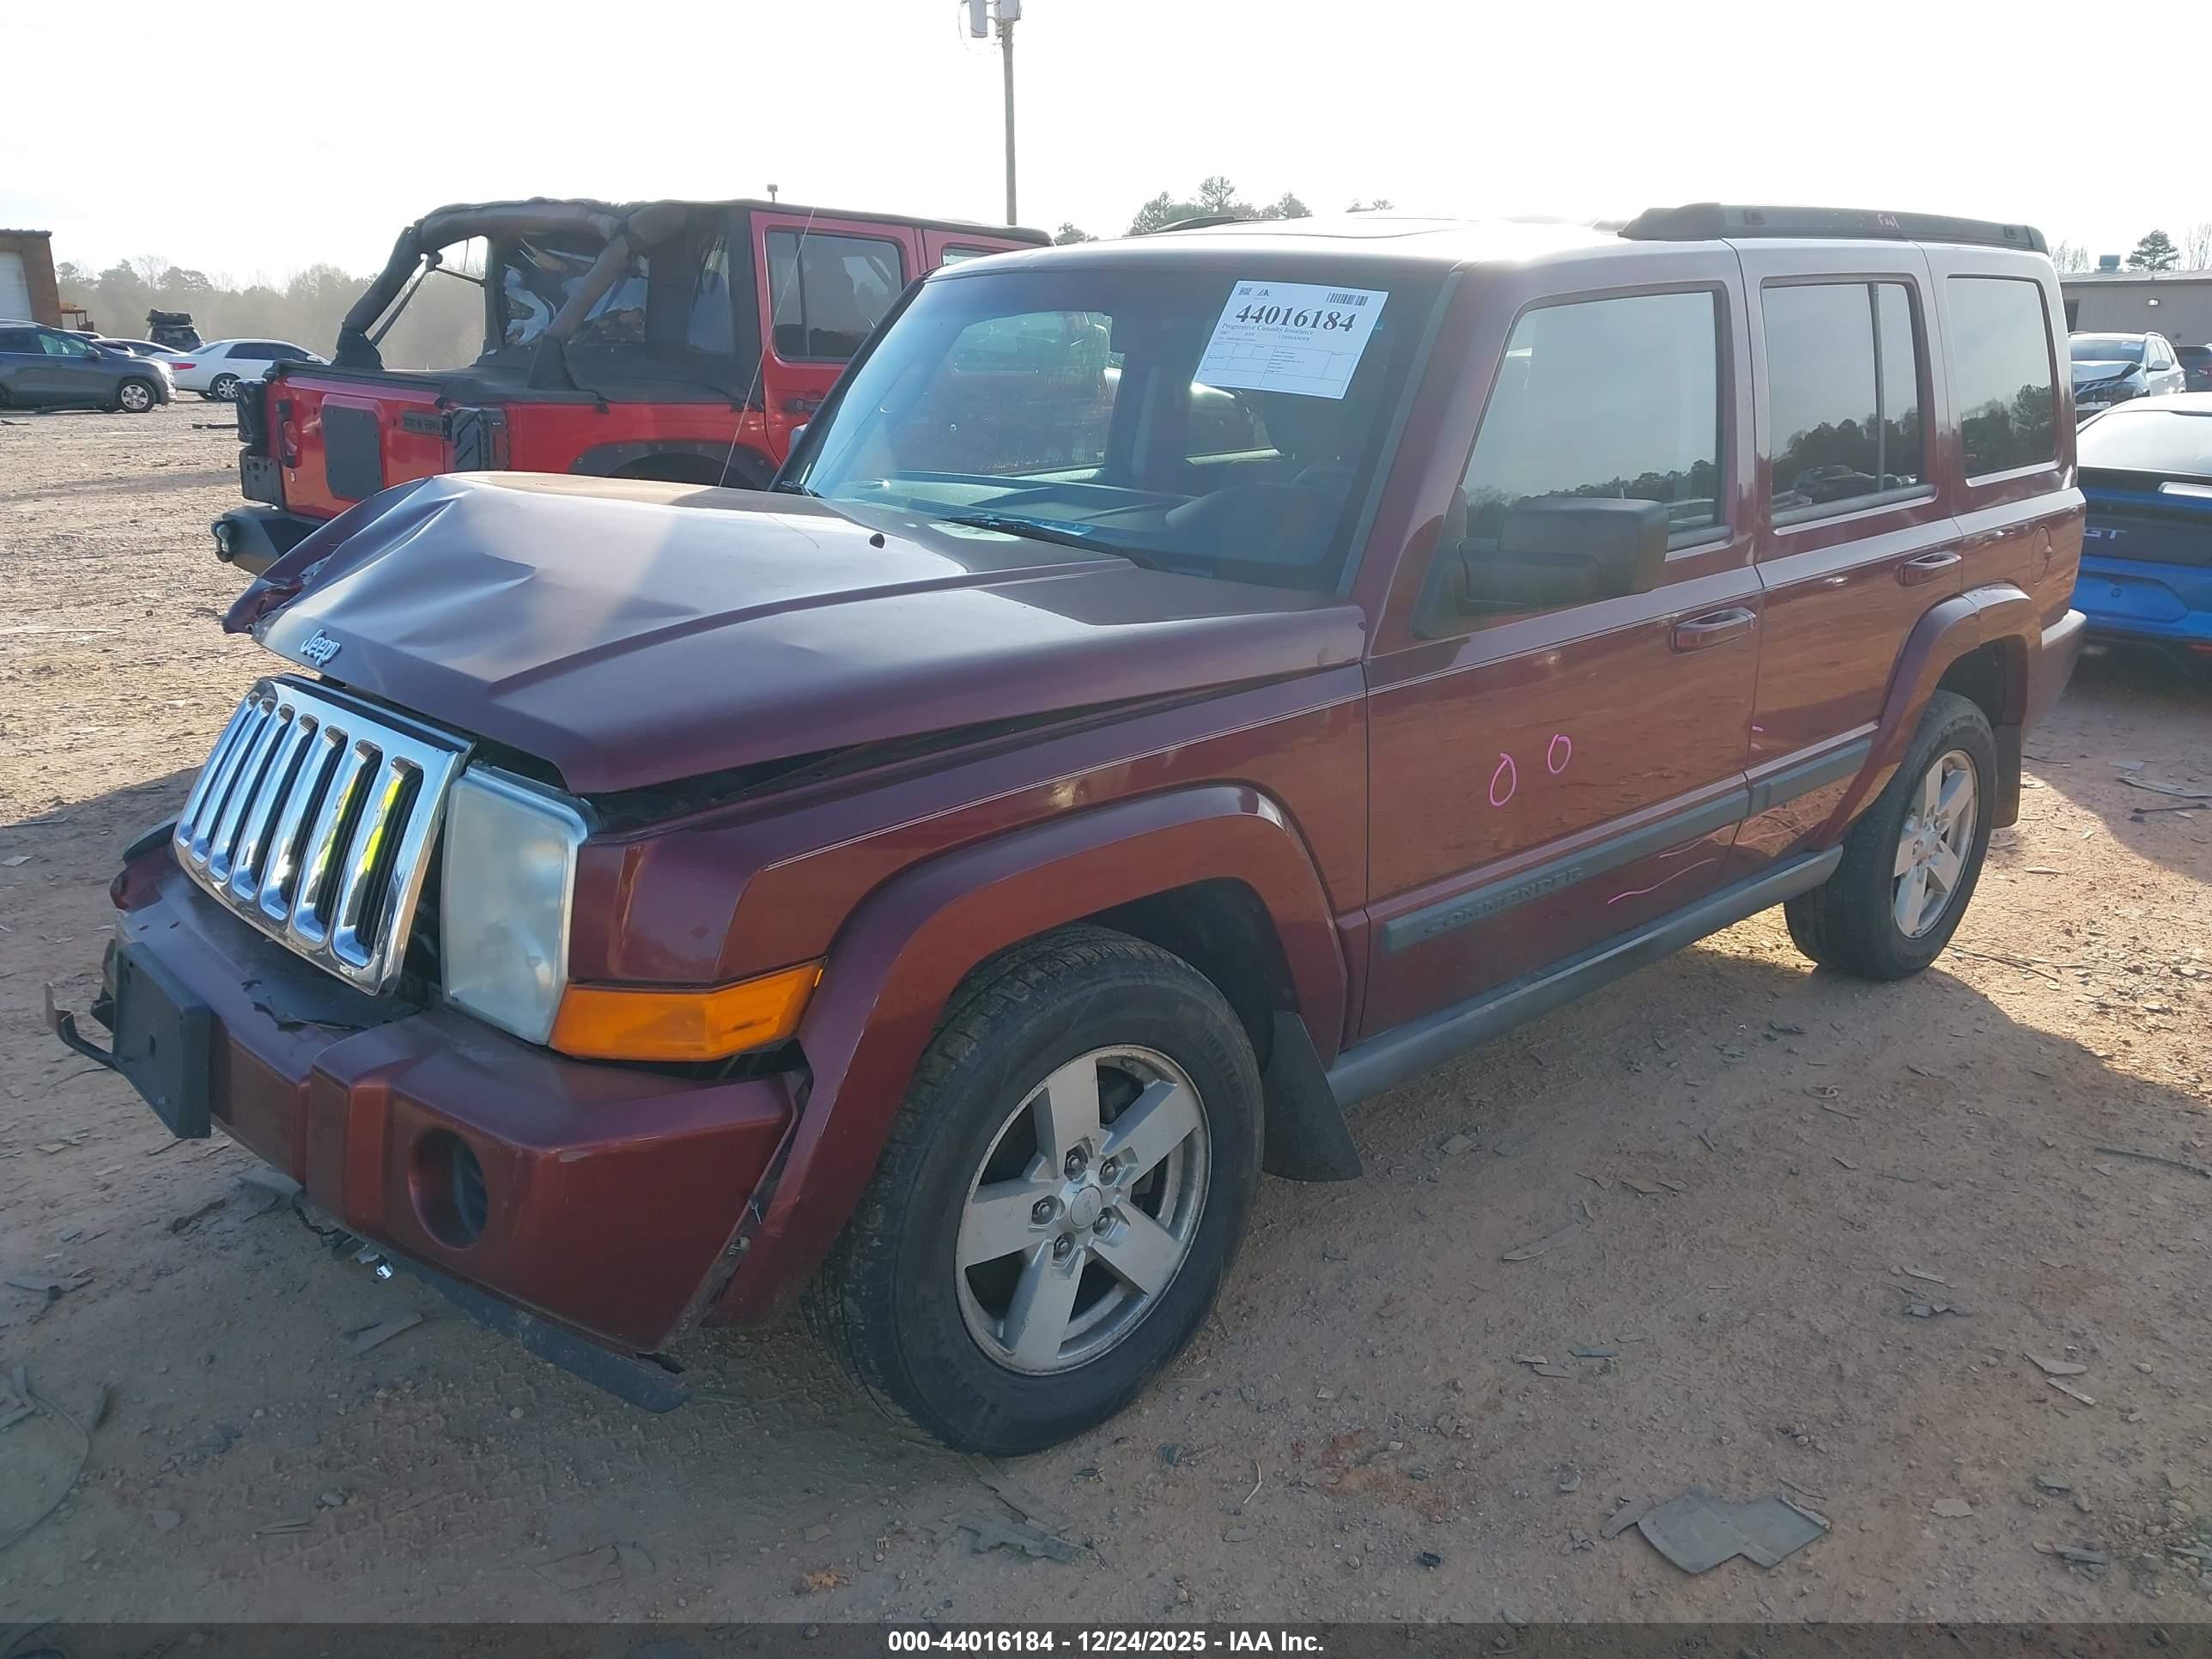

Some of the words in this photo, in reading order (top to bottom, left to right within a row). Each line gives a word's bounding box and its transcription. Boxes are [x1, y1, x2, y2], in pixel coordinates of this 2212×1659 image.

[1236, 304, 1357, 331] 44016184
[1221, 322, 1256, 331] Progressive
[1284, 327, 1315, 336] Insurance
[2084, 527, 2127, 539] GT
[300, 629, 341, 666] Jeep
